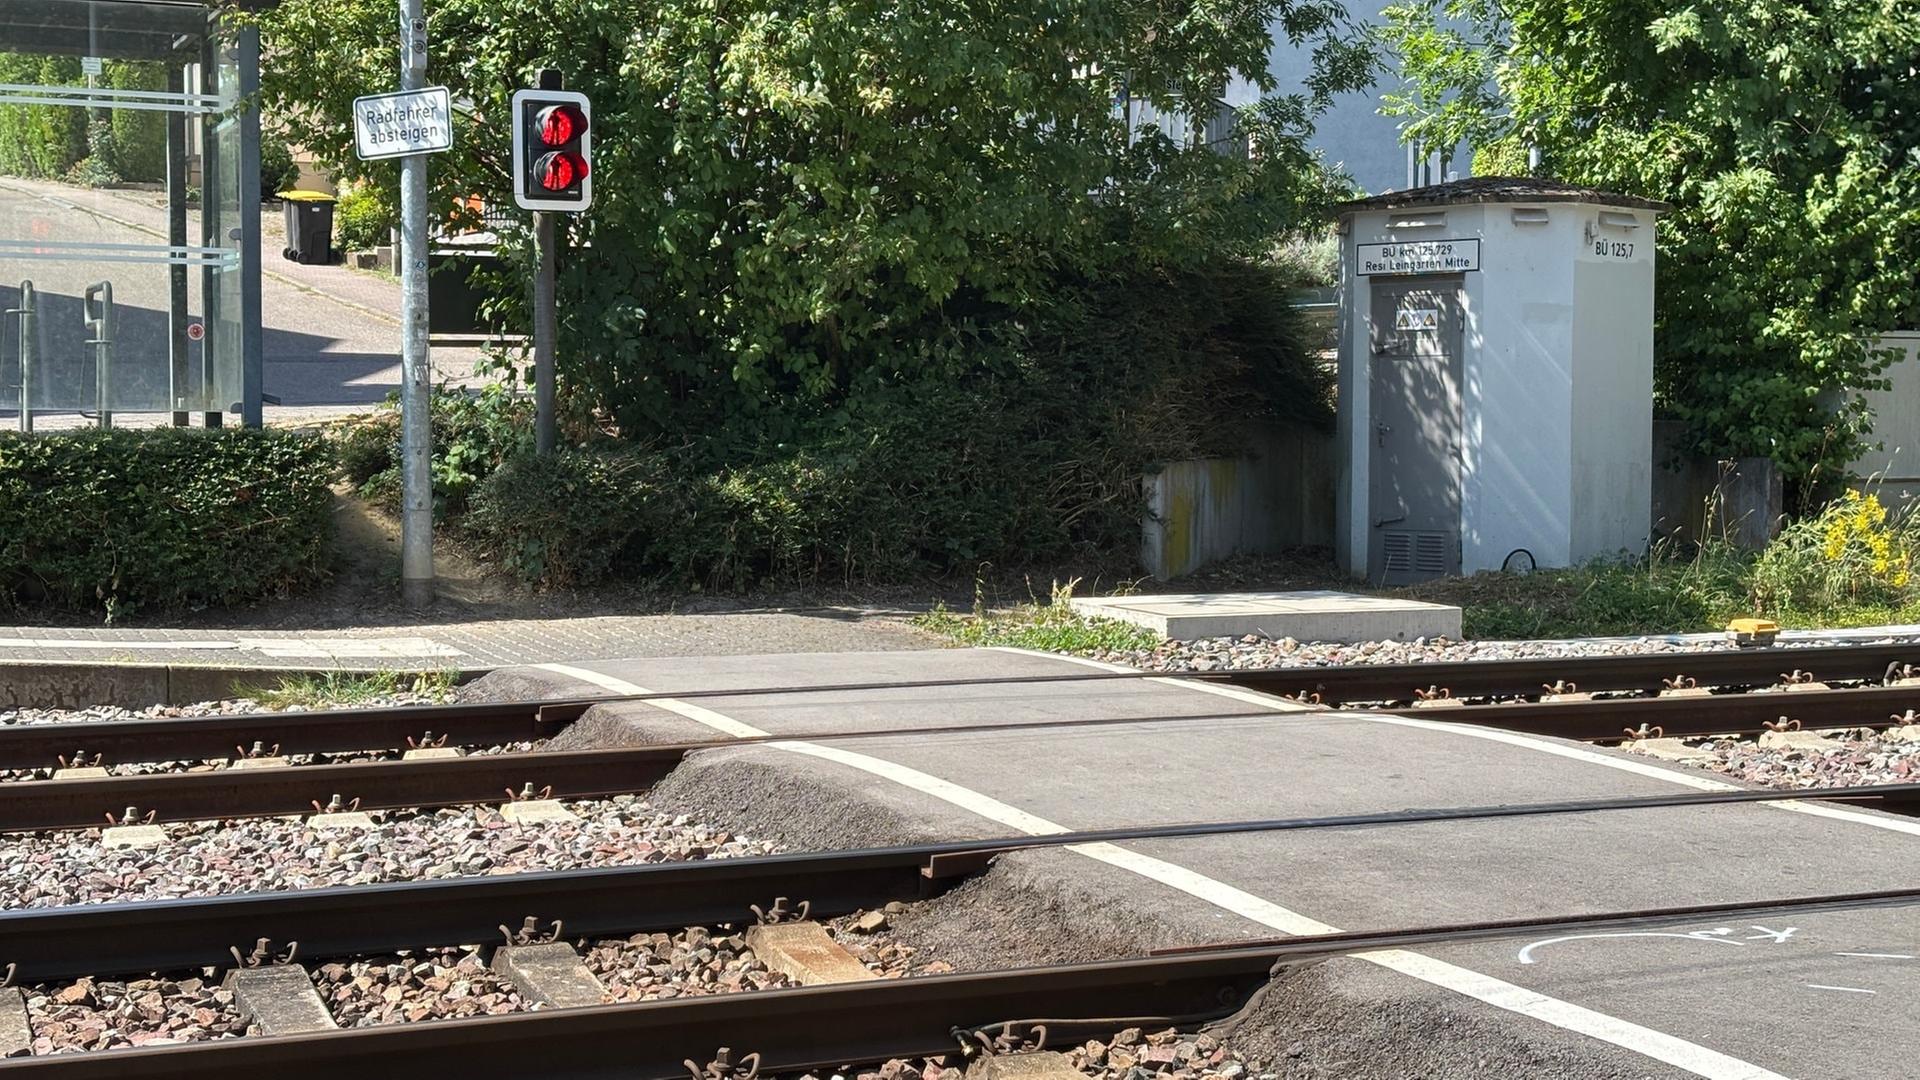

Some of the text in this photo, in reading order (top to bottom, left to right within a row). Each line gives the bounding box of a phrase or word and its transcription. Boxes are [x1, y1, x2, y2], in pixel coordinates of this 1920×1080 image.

[366, 106, 437, 125] Radfahrer
[370, 125, 438, 143] absteigen
[1382, 245, 1453, 258] BÜ km 125,729
[1595, 238, 1634, 259] BÜ 125,7
[1365, 258, 1470, 272] Resi Leingarten Mitte
